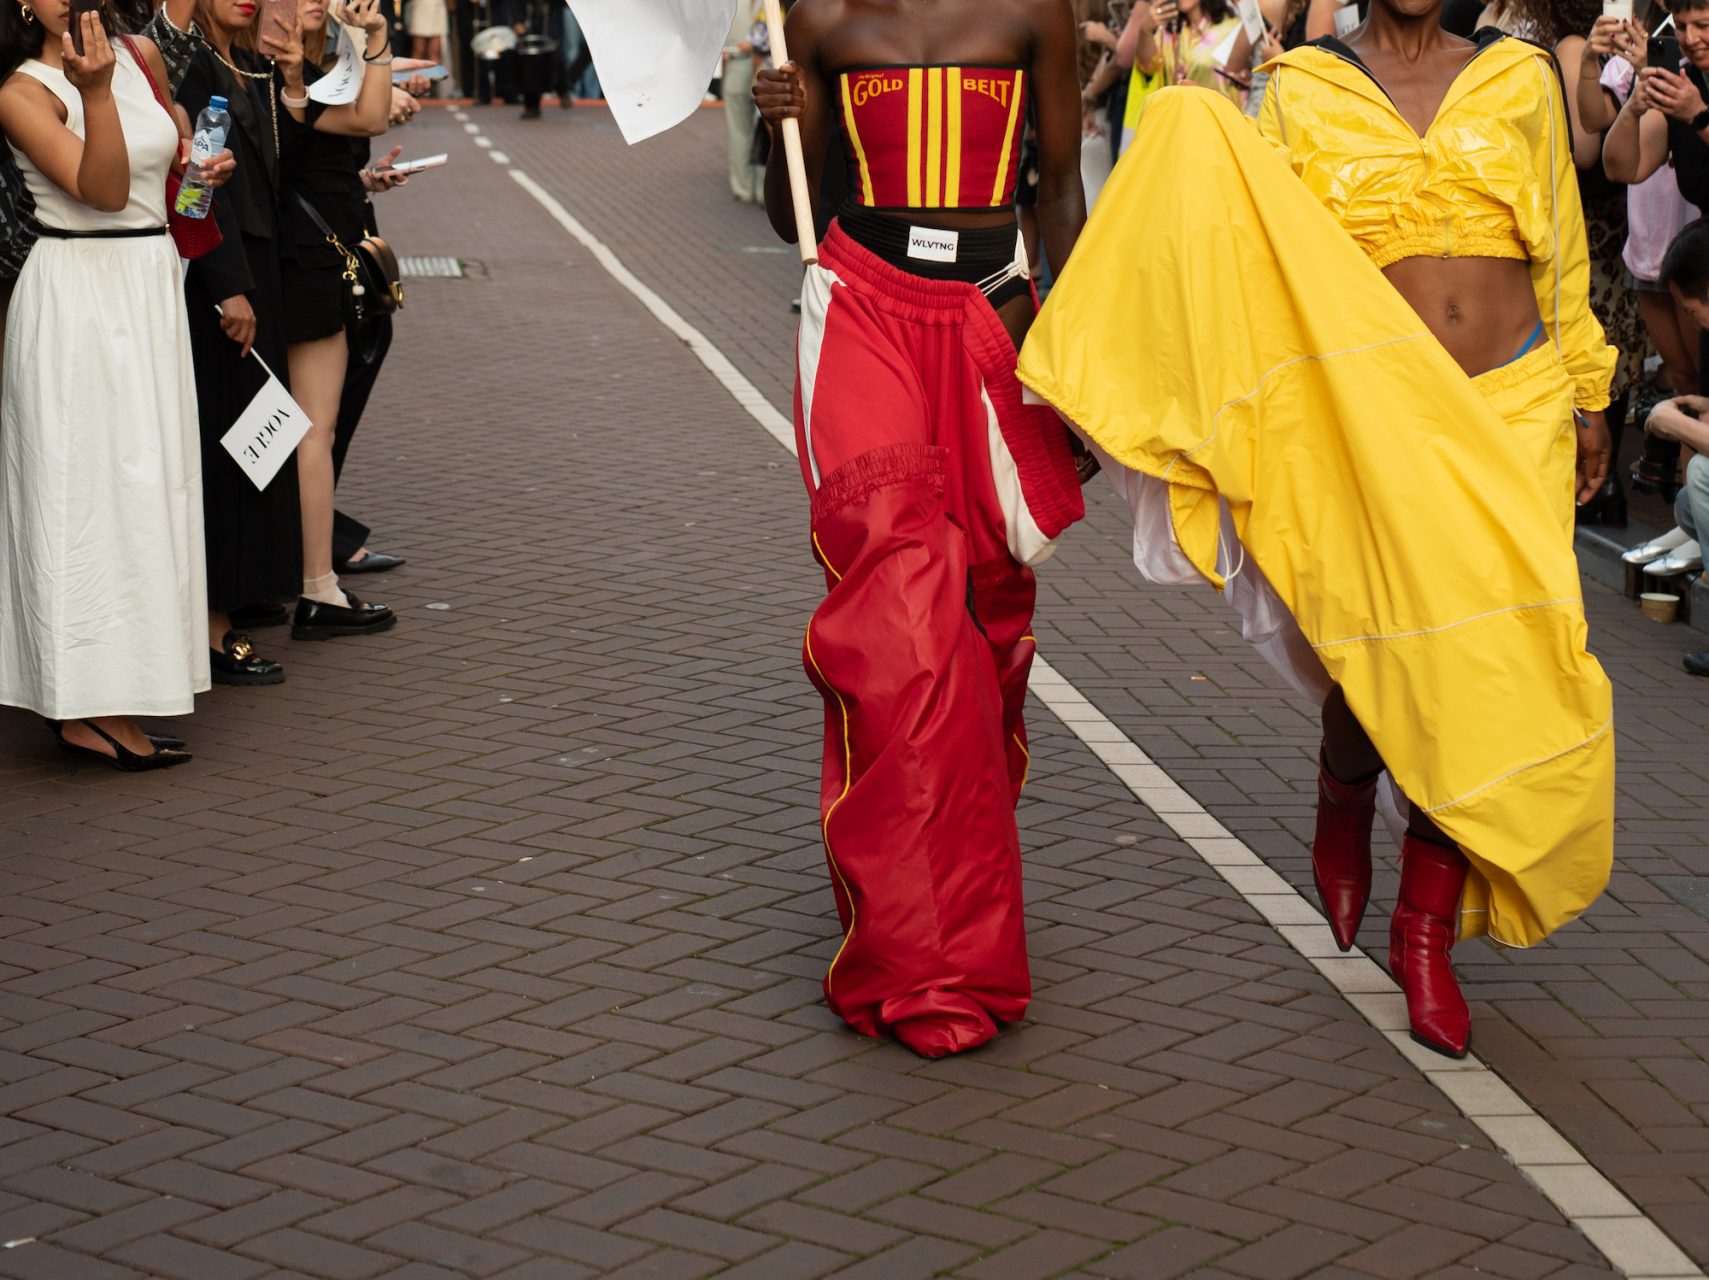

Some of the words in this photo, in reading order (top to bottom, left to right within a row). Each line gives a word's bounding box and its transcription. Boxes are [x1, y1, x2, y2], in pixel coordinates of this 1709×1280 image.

[853, 78, 904, 107] GOLD
[963, 78, 1011, 108] BELT
[911, 238, 955, 251] WLVTNG
[243, 408, 291, 465] VOGUE
